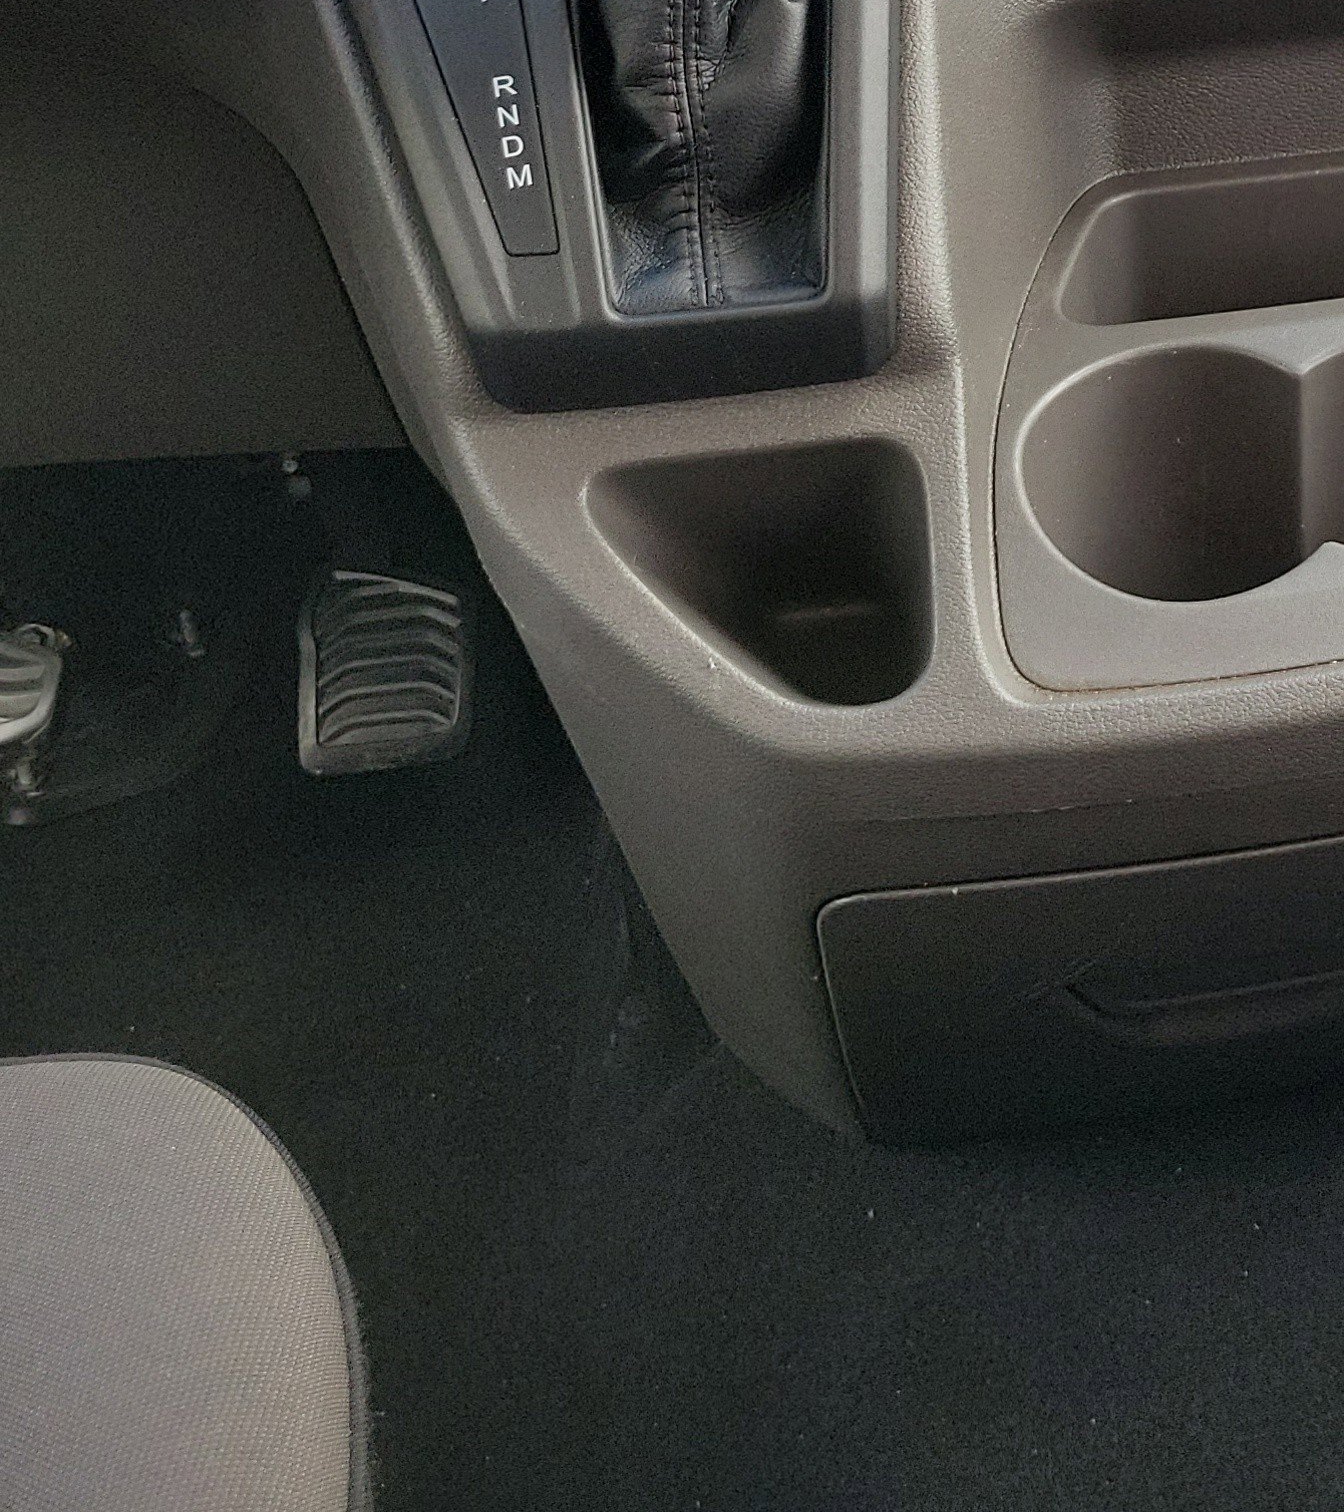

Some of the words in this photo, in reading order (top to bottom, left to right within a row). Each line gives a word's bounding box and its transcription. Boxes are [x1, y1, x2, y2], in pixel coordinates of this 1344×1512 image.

[492, 74, 518, 98] R
[497, 104, 520, 128] N
[502, 135, 524, 158] D
[506, 163, 534, 190] M
